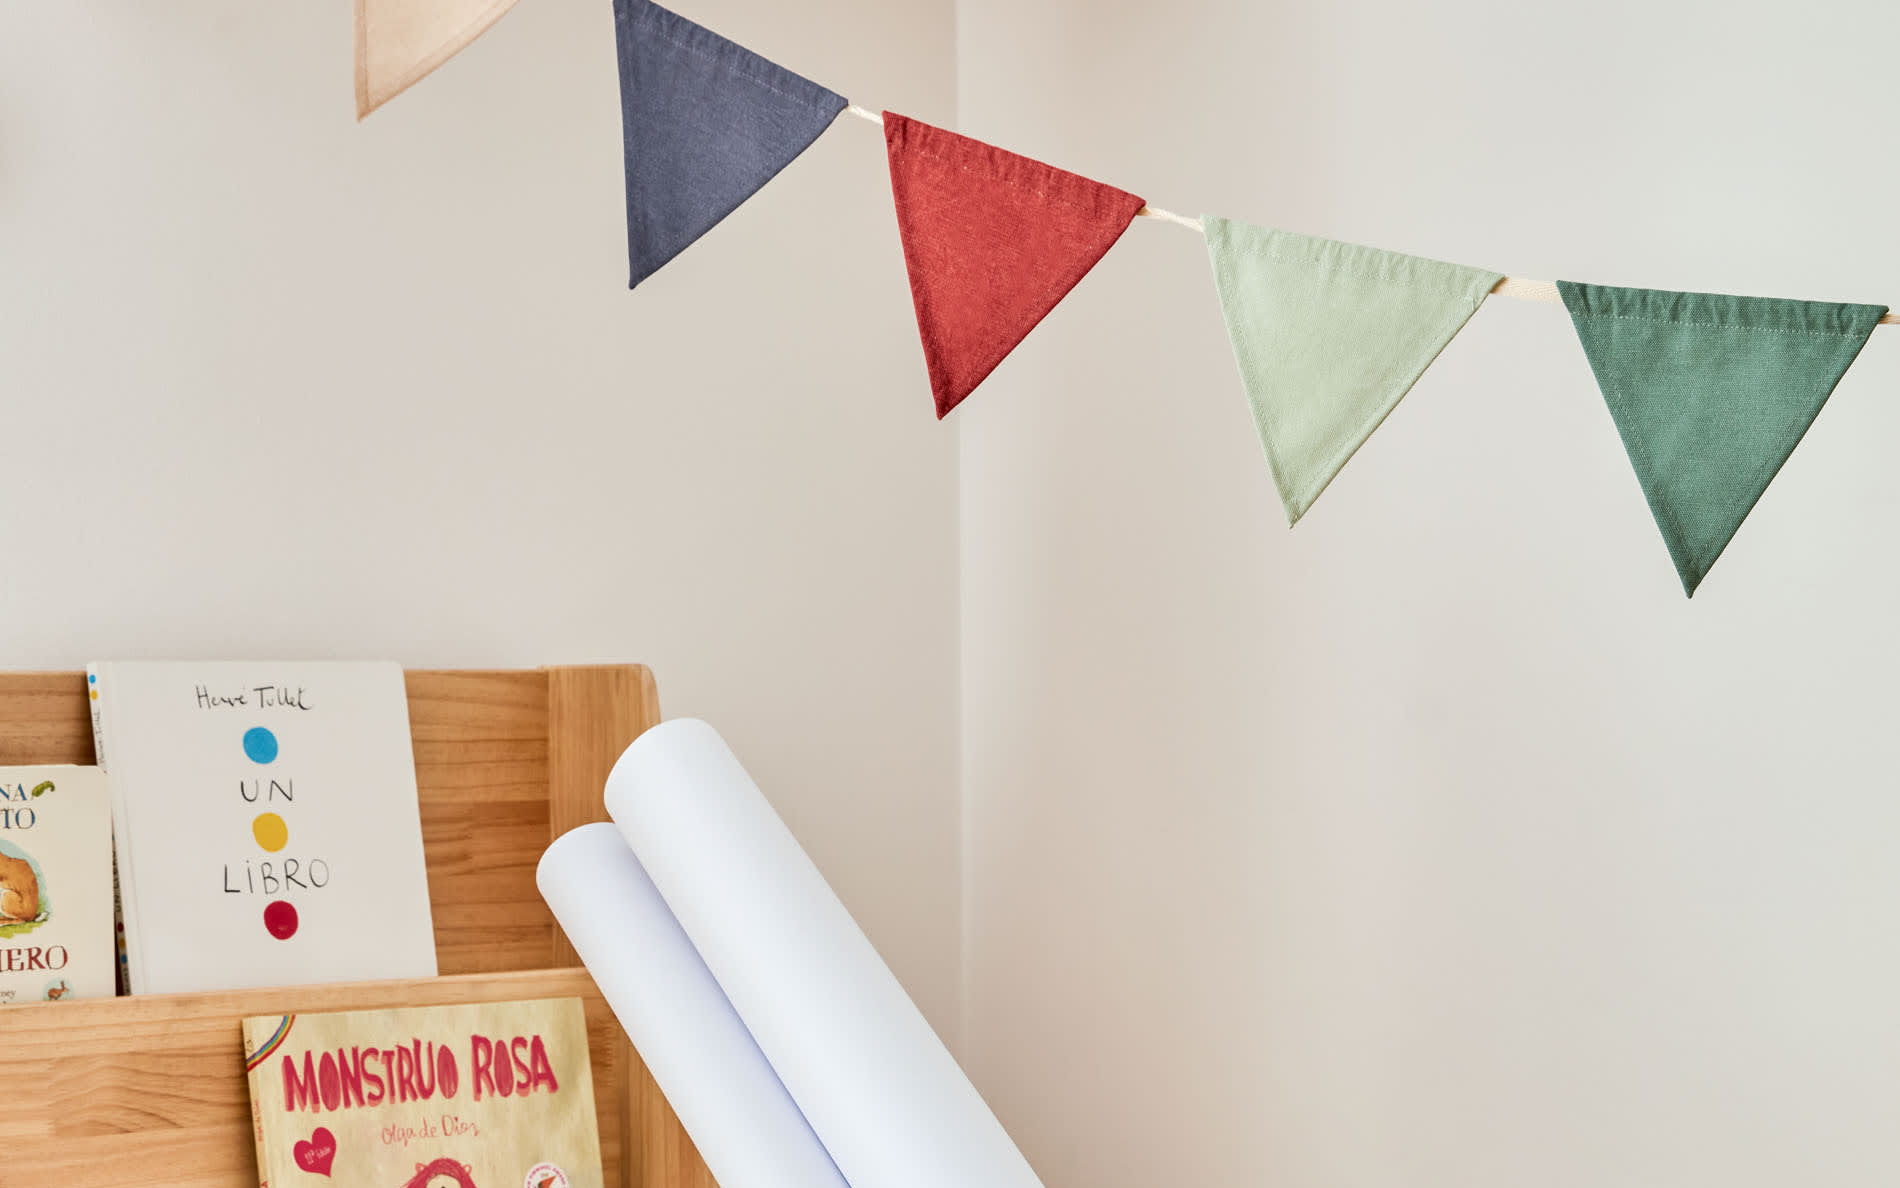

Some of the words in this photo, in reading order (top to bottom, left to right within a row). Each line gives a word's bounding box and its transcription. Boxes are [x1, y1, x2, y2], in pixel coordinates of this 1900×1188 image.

[240, 777, 293, 803] UN
[281, 1037, 459, 1114] MONSTRUO
[470, 1034, 559, 1102] ROSA
[419, 1115, 439, 1138] de
[441, 1114, 480, 1137] Dios
